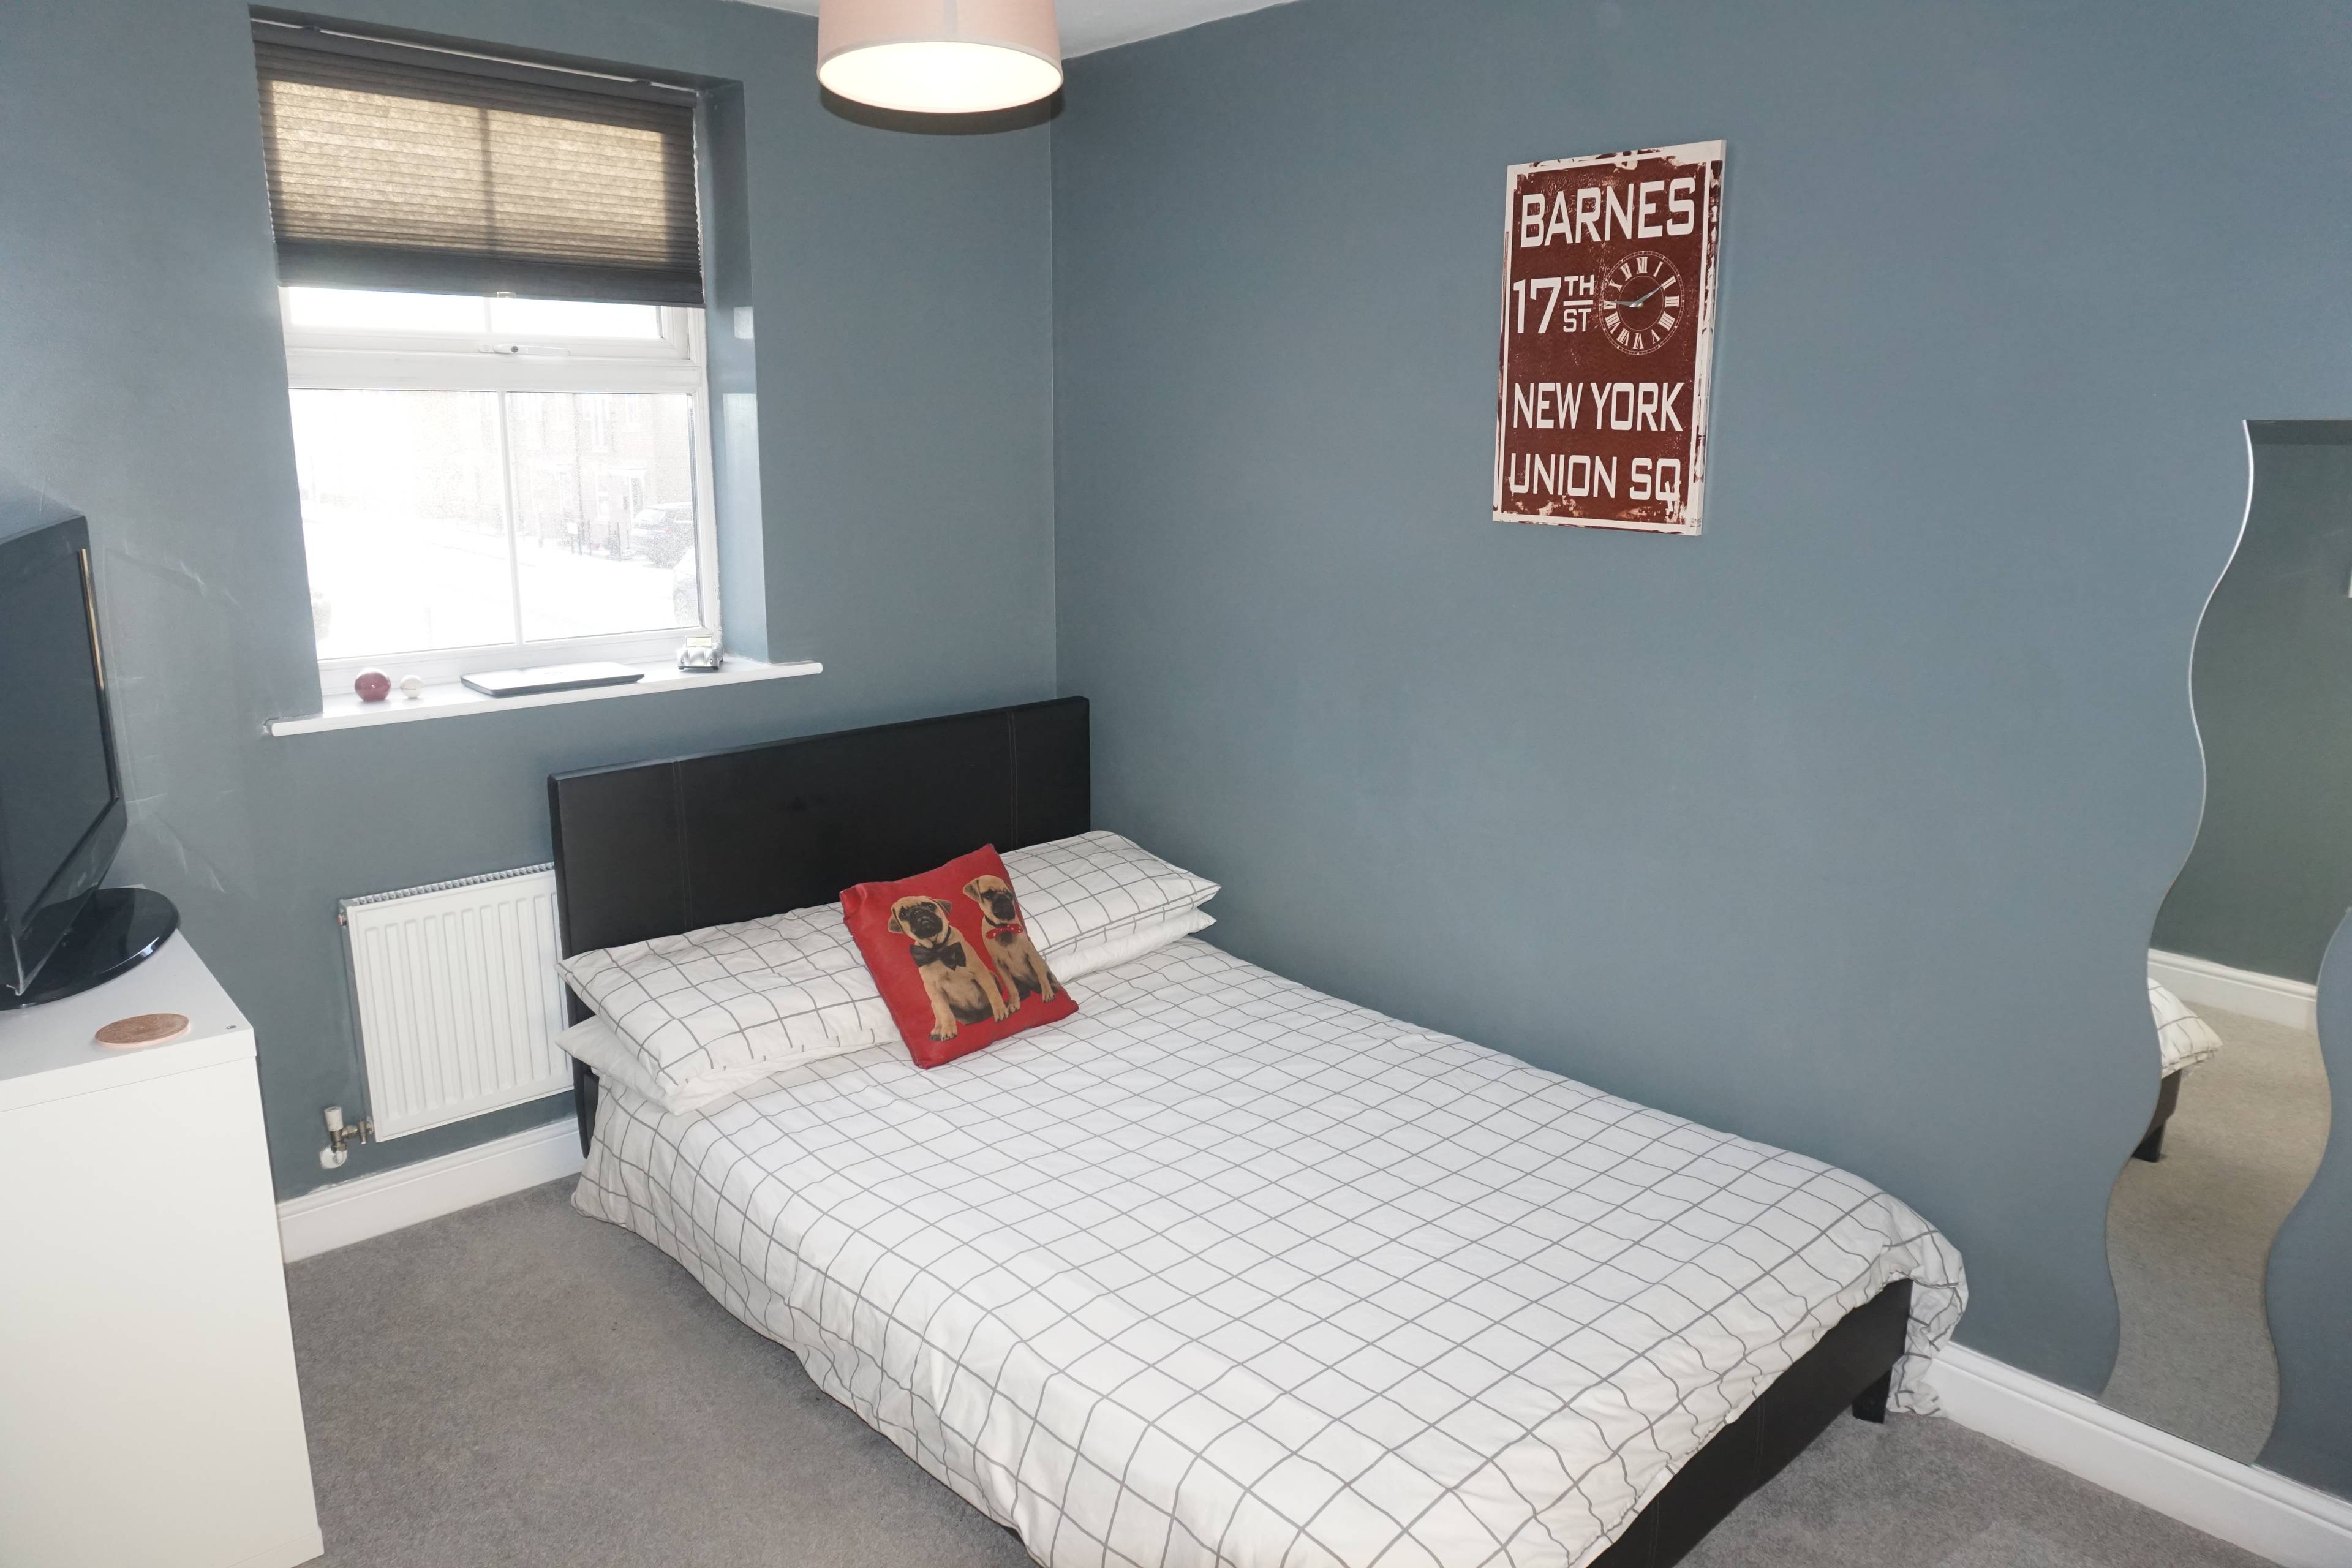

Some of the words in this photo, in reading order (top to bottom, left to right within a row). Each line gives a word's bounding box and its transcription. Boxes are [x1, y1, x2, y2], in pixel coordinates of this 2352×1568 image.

[1521, 177, 1695, 248] BARNES
[1637, 257, 1648, 274] XII
[1660, 276, 1676, 291] II
[1513, 277, 1561, 334] 17
[1563, 275, 1595, 296] TH
[1665, 295, 1679, 307] III
[1563, 307, 1592, 333] ST
[1605, 311, 1621, 334] VIII
[1658, 311, 1675, 331] IIII
[1616, 328, 1630, 346] VII
[1633, 333, 1645, 349] VI
[1651, 329, 1660, 344] V
[1513, 382, 1583, 429] NEW
[1591, 382, 1684, 432] YORK
[1510, 453, 1617, 499] UNION
[1629, 458, 1681, 513] SQ
